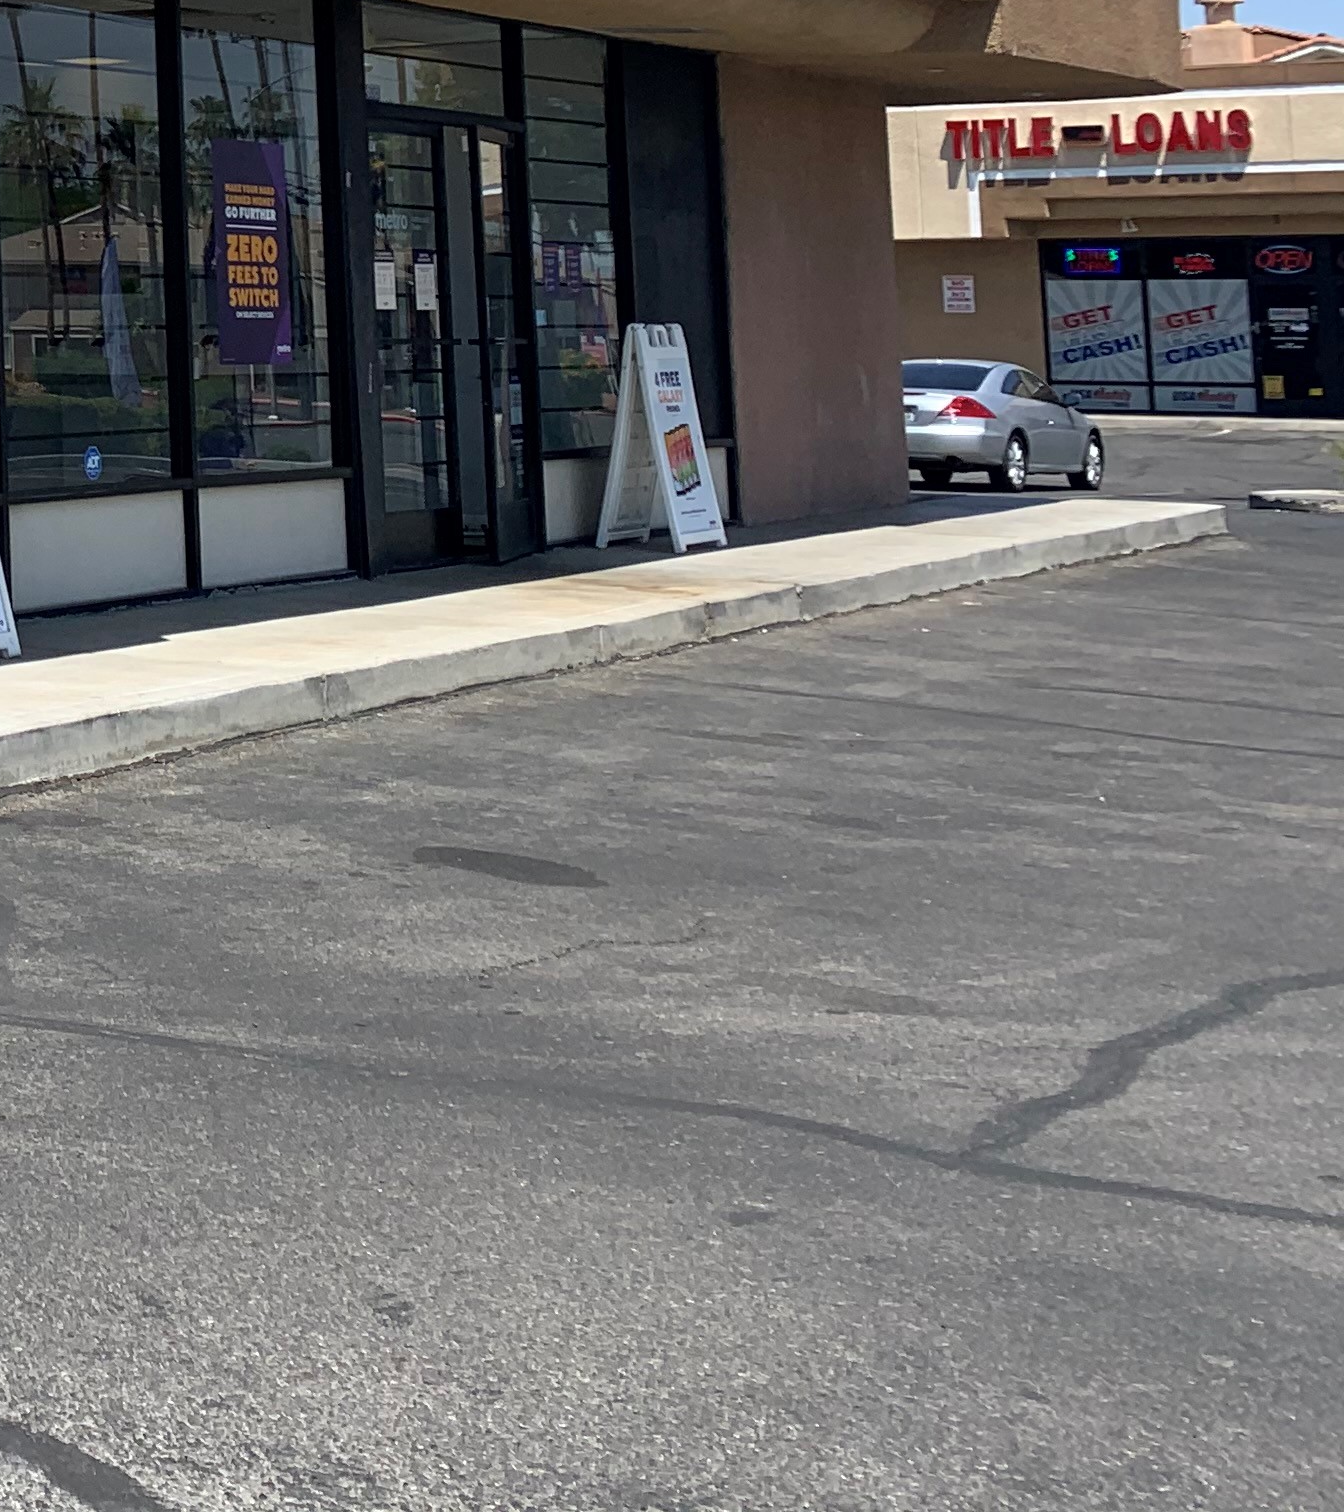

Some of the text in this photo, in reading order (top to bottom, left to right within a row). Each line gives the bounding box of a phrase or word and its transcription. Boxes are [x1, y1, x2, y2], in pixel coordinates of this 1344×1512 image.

[945, 109, 1253, 160] TITLE LOANS
[225, 205, 277, 222] GO FURTHER
[374, 208, 409, 231] metro
[226, 234, 278, 264] ZERO
[1254, 249, 1313, 269] OPEN
[228, 264, 279, 286] FEES TO
[229, 287, 280, 308] SWITCH
[1063, 305, 1113, 329] GET
[1166, 304, 1217, 329] GET
[1062, 334, 1143, 364] CASH!
[1165, 334, 1249, 365] CASH!
[661, 371, 681, 387] FREE
